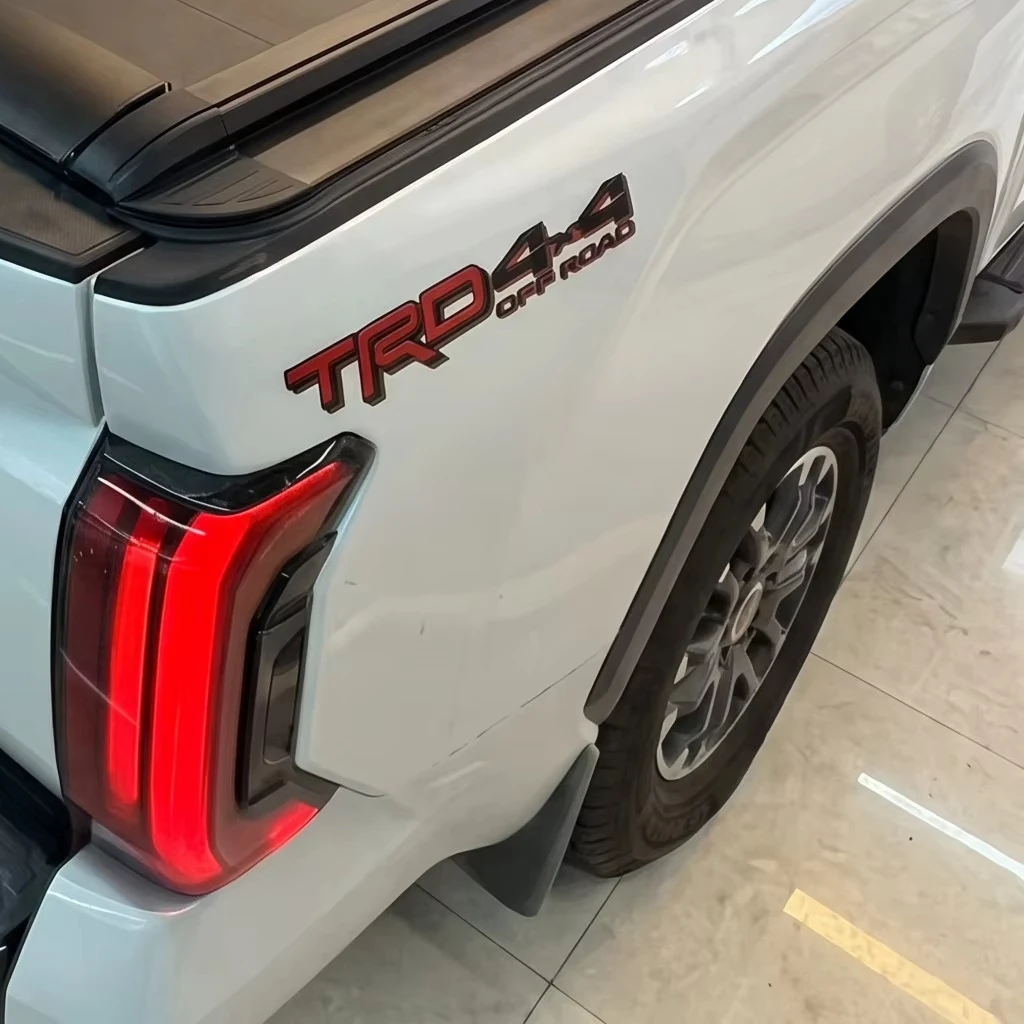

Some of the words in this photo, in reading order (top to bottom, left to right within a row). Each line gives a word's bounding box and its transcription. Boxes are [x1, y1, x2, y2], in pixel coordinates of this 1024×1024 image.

[495, 271, 557, 319] OFF
[559, 219, 637, 280] ROAD
[284, 264, 496, 414] TRD
